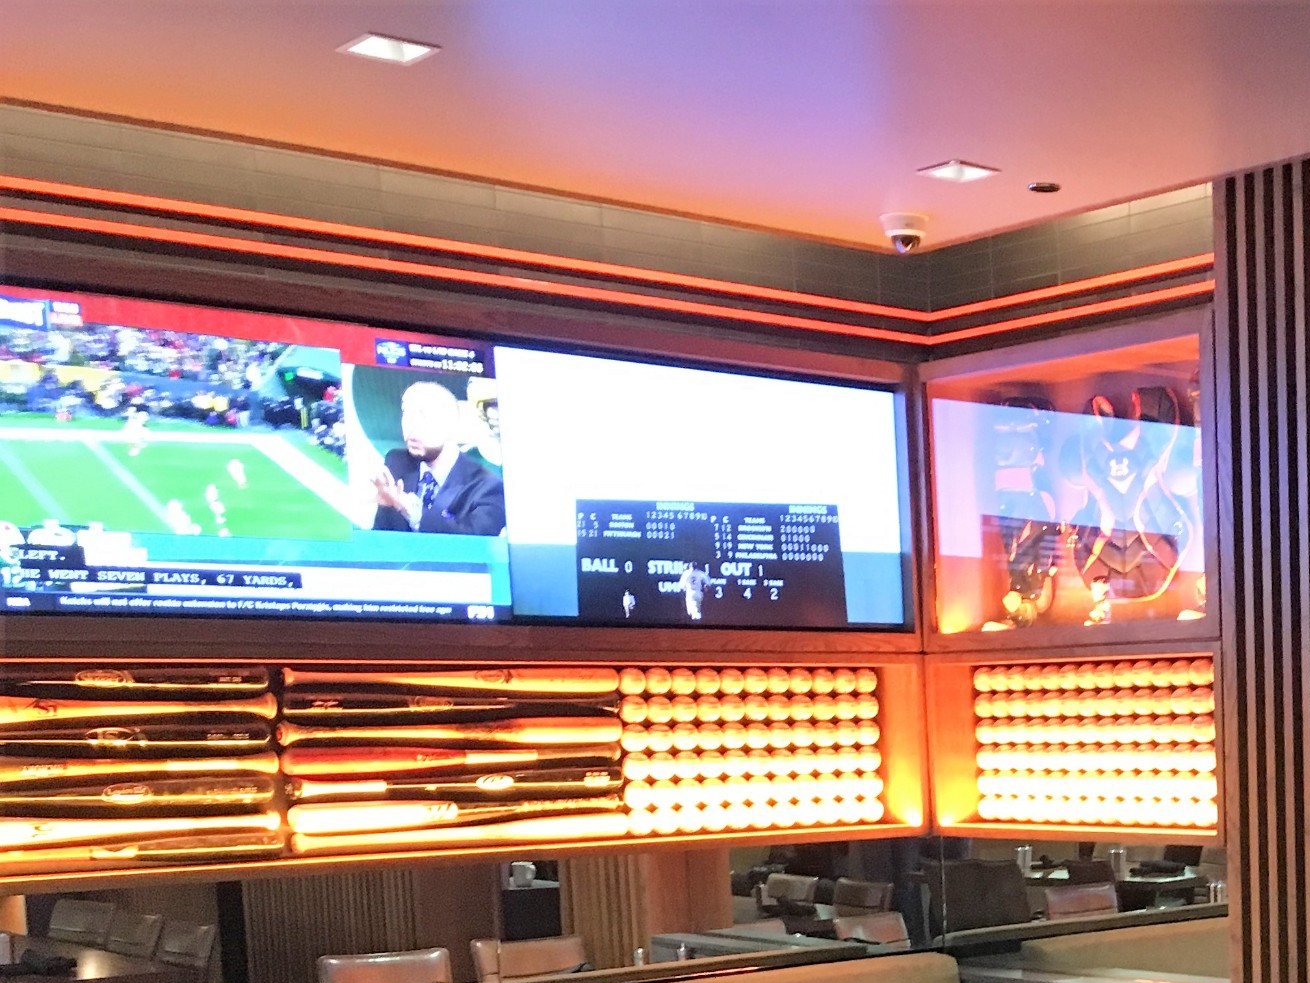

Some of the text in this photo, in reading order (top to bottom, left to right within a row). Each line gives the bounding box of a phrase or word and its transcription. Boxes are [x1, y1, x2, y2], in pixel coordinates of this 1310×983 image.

[581, 558, 619, 573] BALL
[720, 561, 752, 576] OUT
[48, 569, 89, 580] WENT
[97, 571, 145, 582] SEVEN
[153, 572, 207, 585] PLAYS,
[217, 574, 235, 584] 67
[243, 575, 294, 588] YARDS,
[715, 586, 779, 600] 3 4 2
